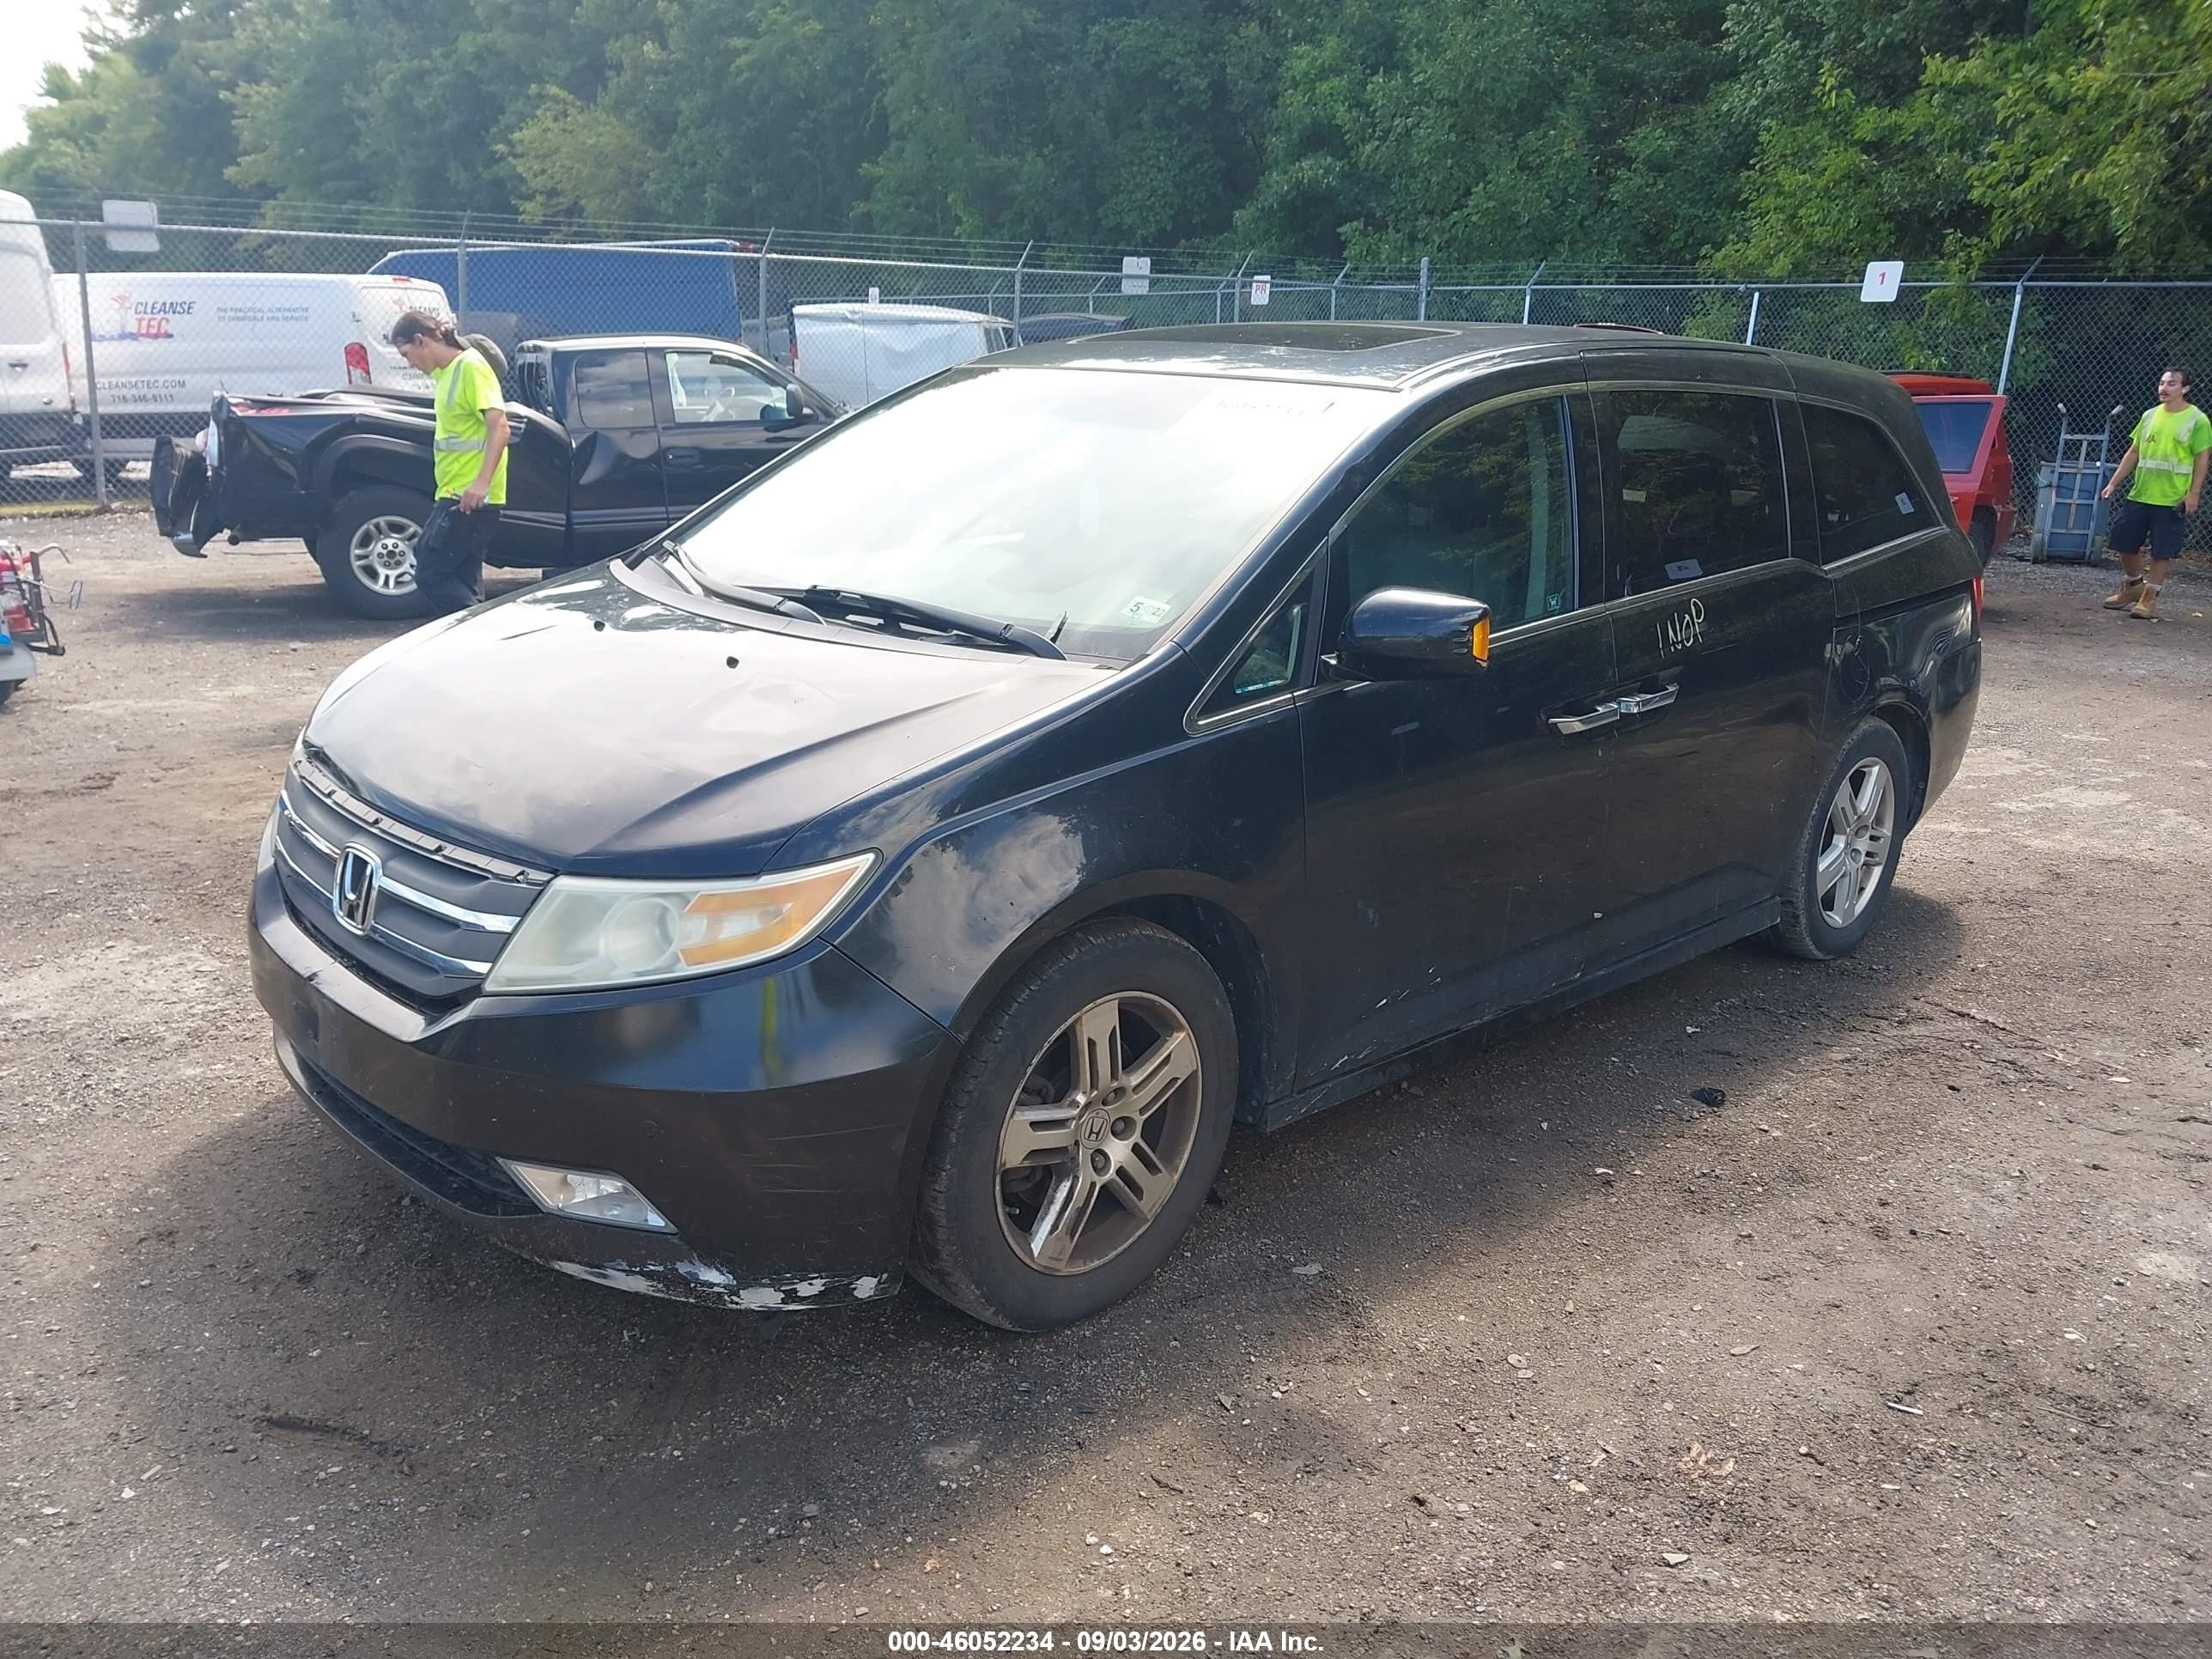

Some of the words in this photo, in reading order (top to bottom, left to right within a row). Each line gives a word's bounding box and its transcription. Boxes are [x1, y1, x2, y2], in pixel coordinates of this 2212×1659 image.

[1879, 271, 1886, 285] 1
[135, 301, 196, 314] CLEANSE
[136, 317, 169, 337] TEC
